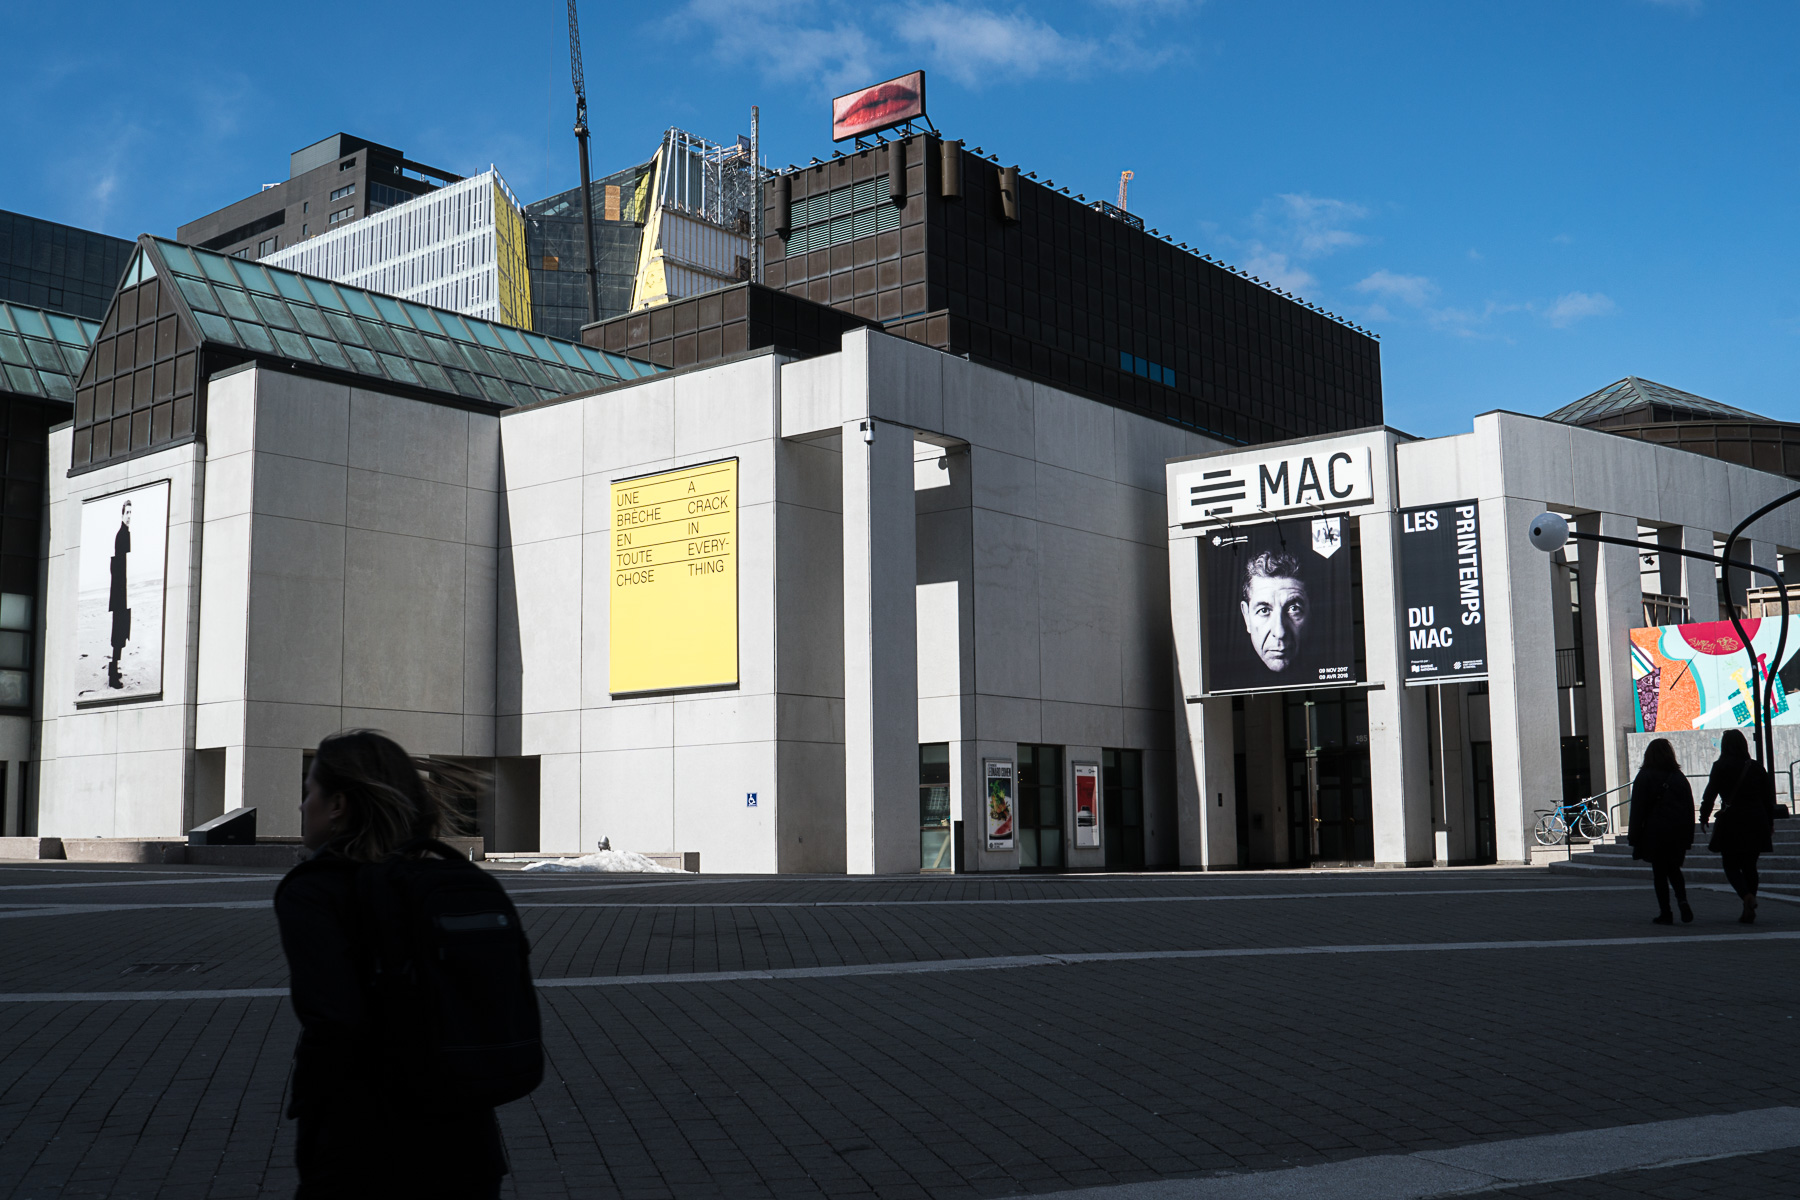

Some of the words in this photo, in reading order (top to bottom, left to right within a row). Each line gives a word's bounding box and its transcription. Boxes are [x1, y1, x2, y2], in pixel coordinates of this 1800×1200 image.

[688, 481, 696, 493] A
[1259, 452, 1354, 508] MAC
[617, 491, 639, 506] UNE
[688, 495, 728, 514] CRACK
[617, 507, 661, 526] BRÈCHE
[1403, 510, 1439, 533] LES
[688, 521, 699, 535] IN
[617, 533, 631, 546] EN
[688, 538, 729, 555] EVERY-
[617, 550, 652, 566] TOUTE
[1455, 505, 1481, 625] PRINTEMPS
[688, 560, 724, 576] THING
[617, 570, 654, 586] CHOSE
[1408, 606, 1434, 628] DU
[1409, 627, 1453, 650] MAC
